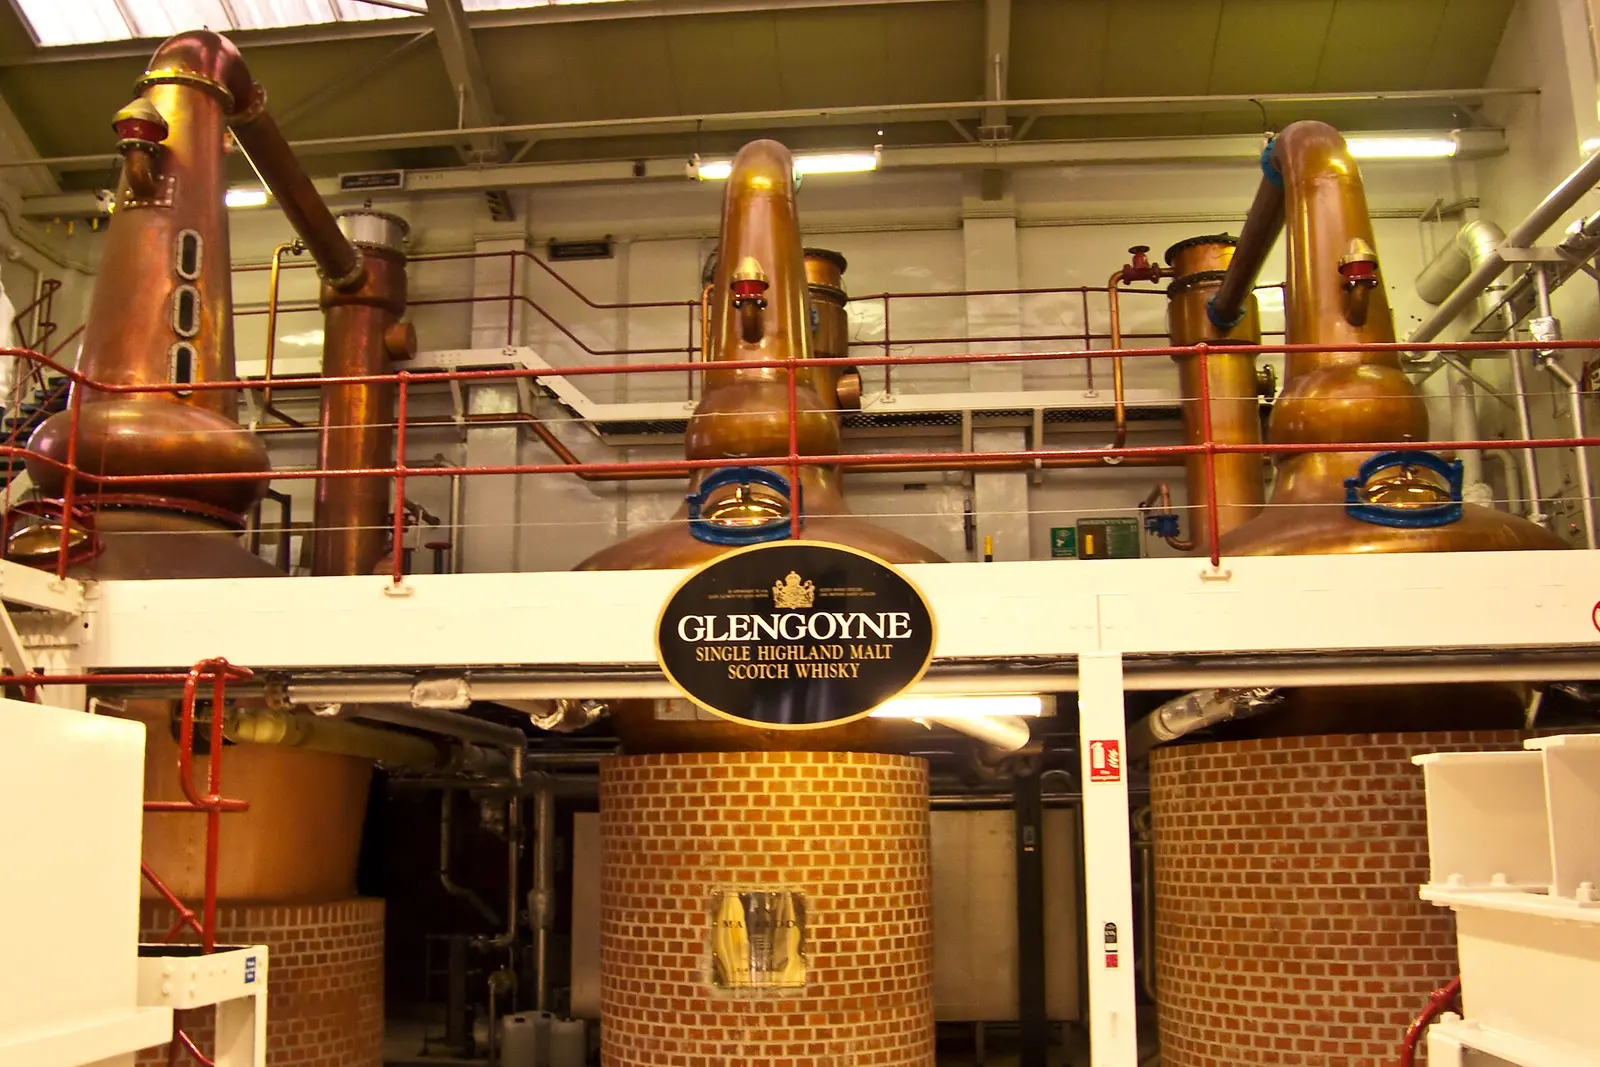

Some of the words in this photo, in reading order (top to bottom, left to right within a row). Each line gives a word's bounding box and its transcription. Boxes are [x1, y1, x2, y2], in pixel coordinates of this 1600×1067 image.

[677, 611, 912, 642] GLENGOYNE
[695, 645, 751, 662] SINGLE
[757, 644, 845, 661] HIGHLAND
[850, 644, 893, 660] MALT
[727, 663, 789, 680] SCOTCH
[795, 663, 861, 679] WHISKY
